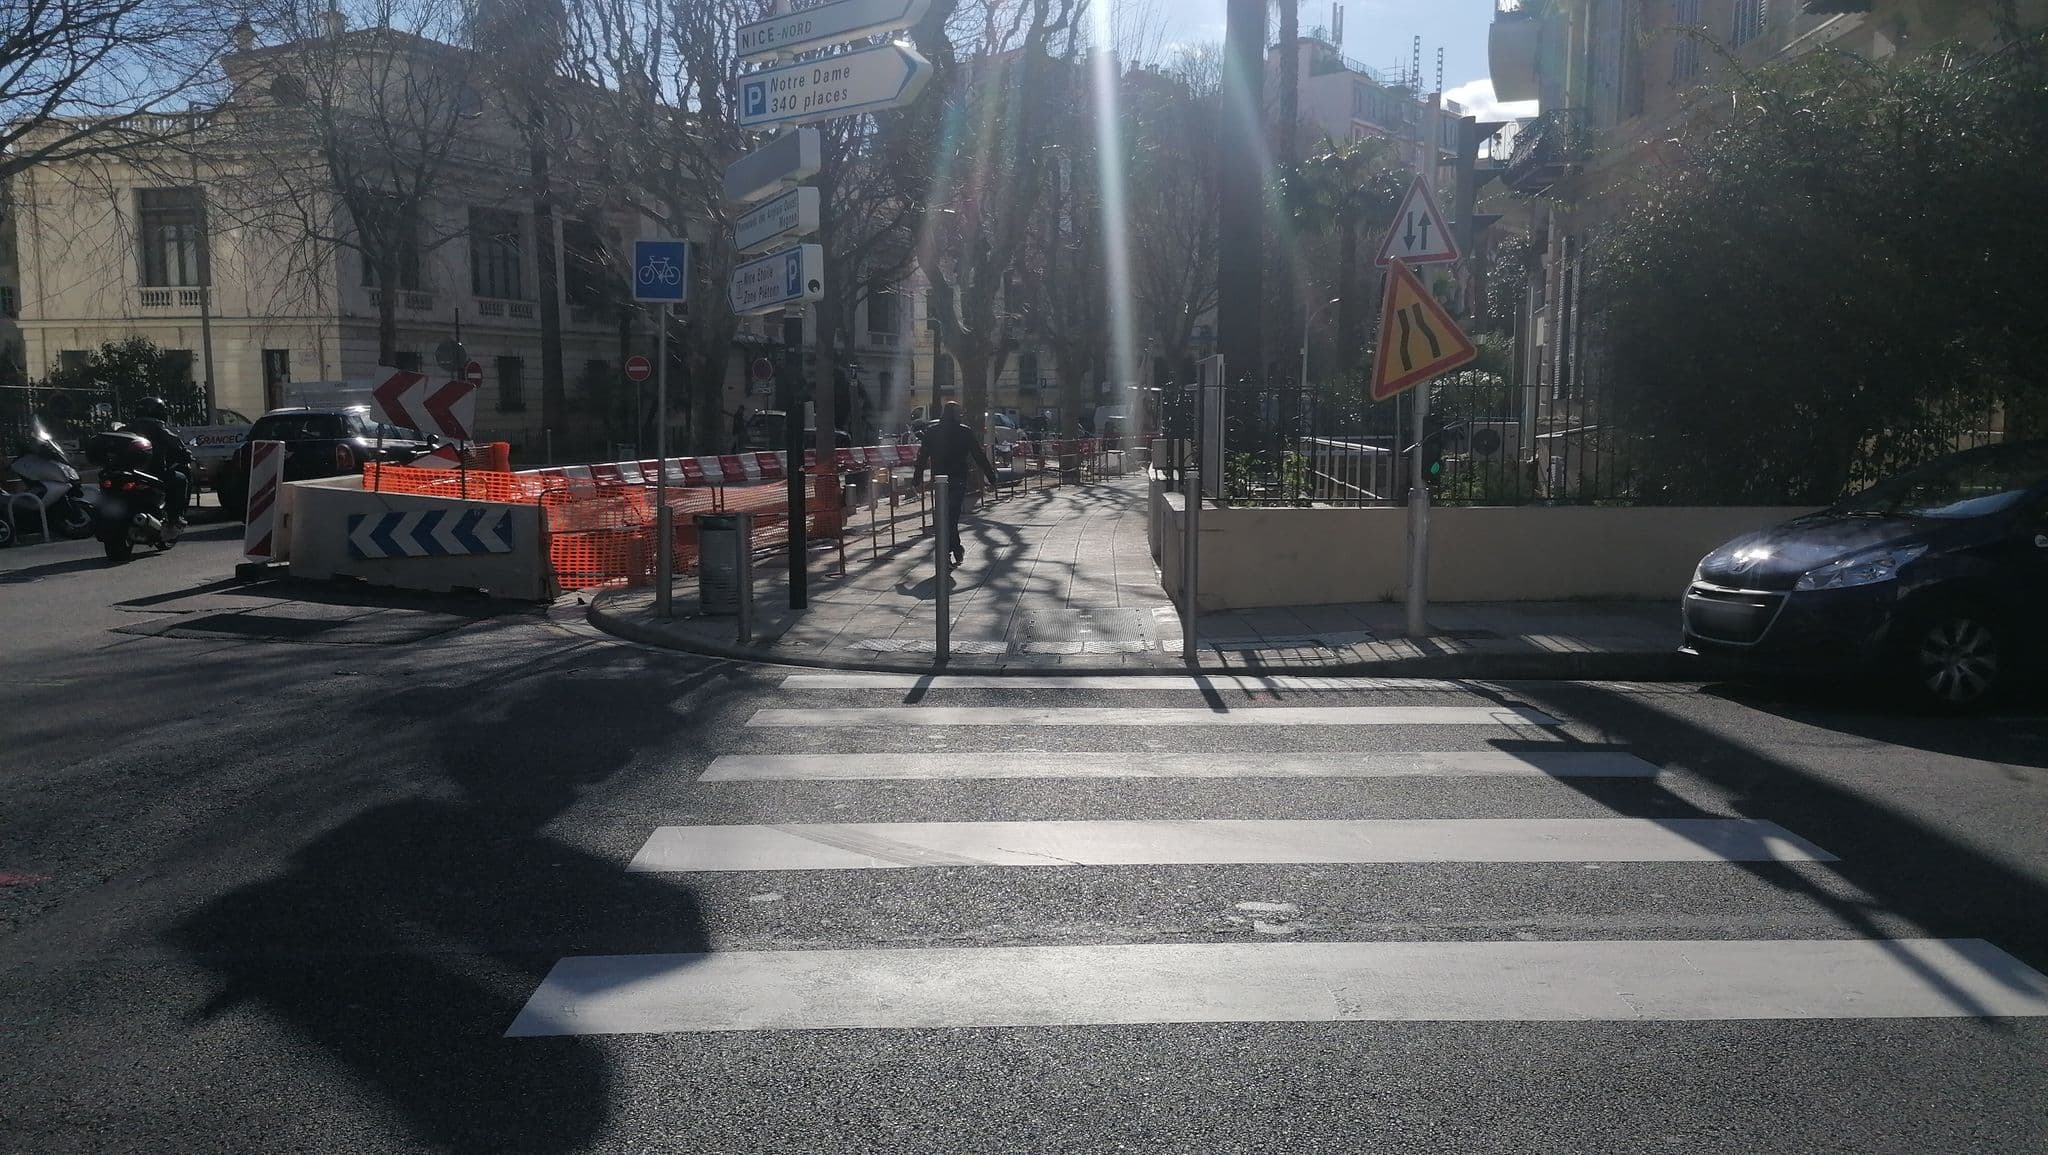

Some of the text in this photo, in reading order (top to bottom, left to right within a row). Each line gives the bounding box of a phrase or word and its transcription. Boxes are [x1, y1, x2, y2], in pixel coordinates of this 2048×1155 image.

[742, 21, 812, 49] NICE-NORD
[770, 67, 851, 93] Notre Dame
[750, 86, 762, 114] P
[771, 89, 848, 113] 340 places
